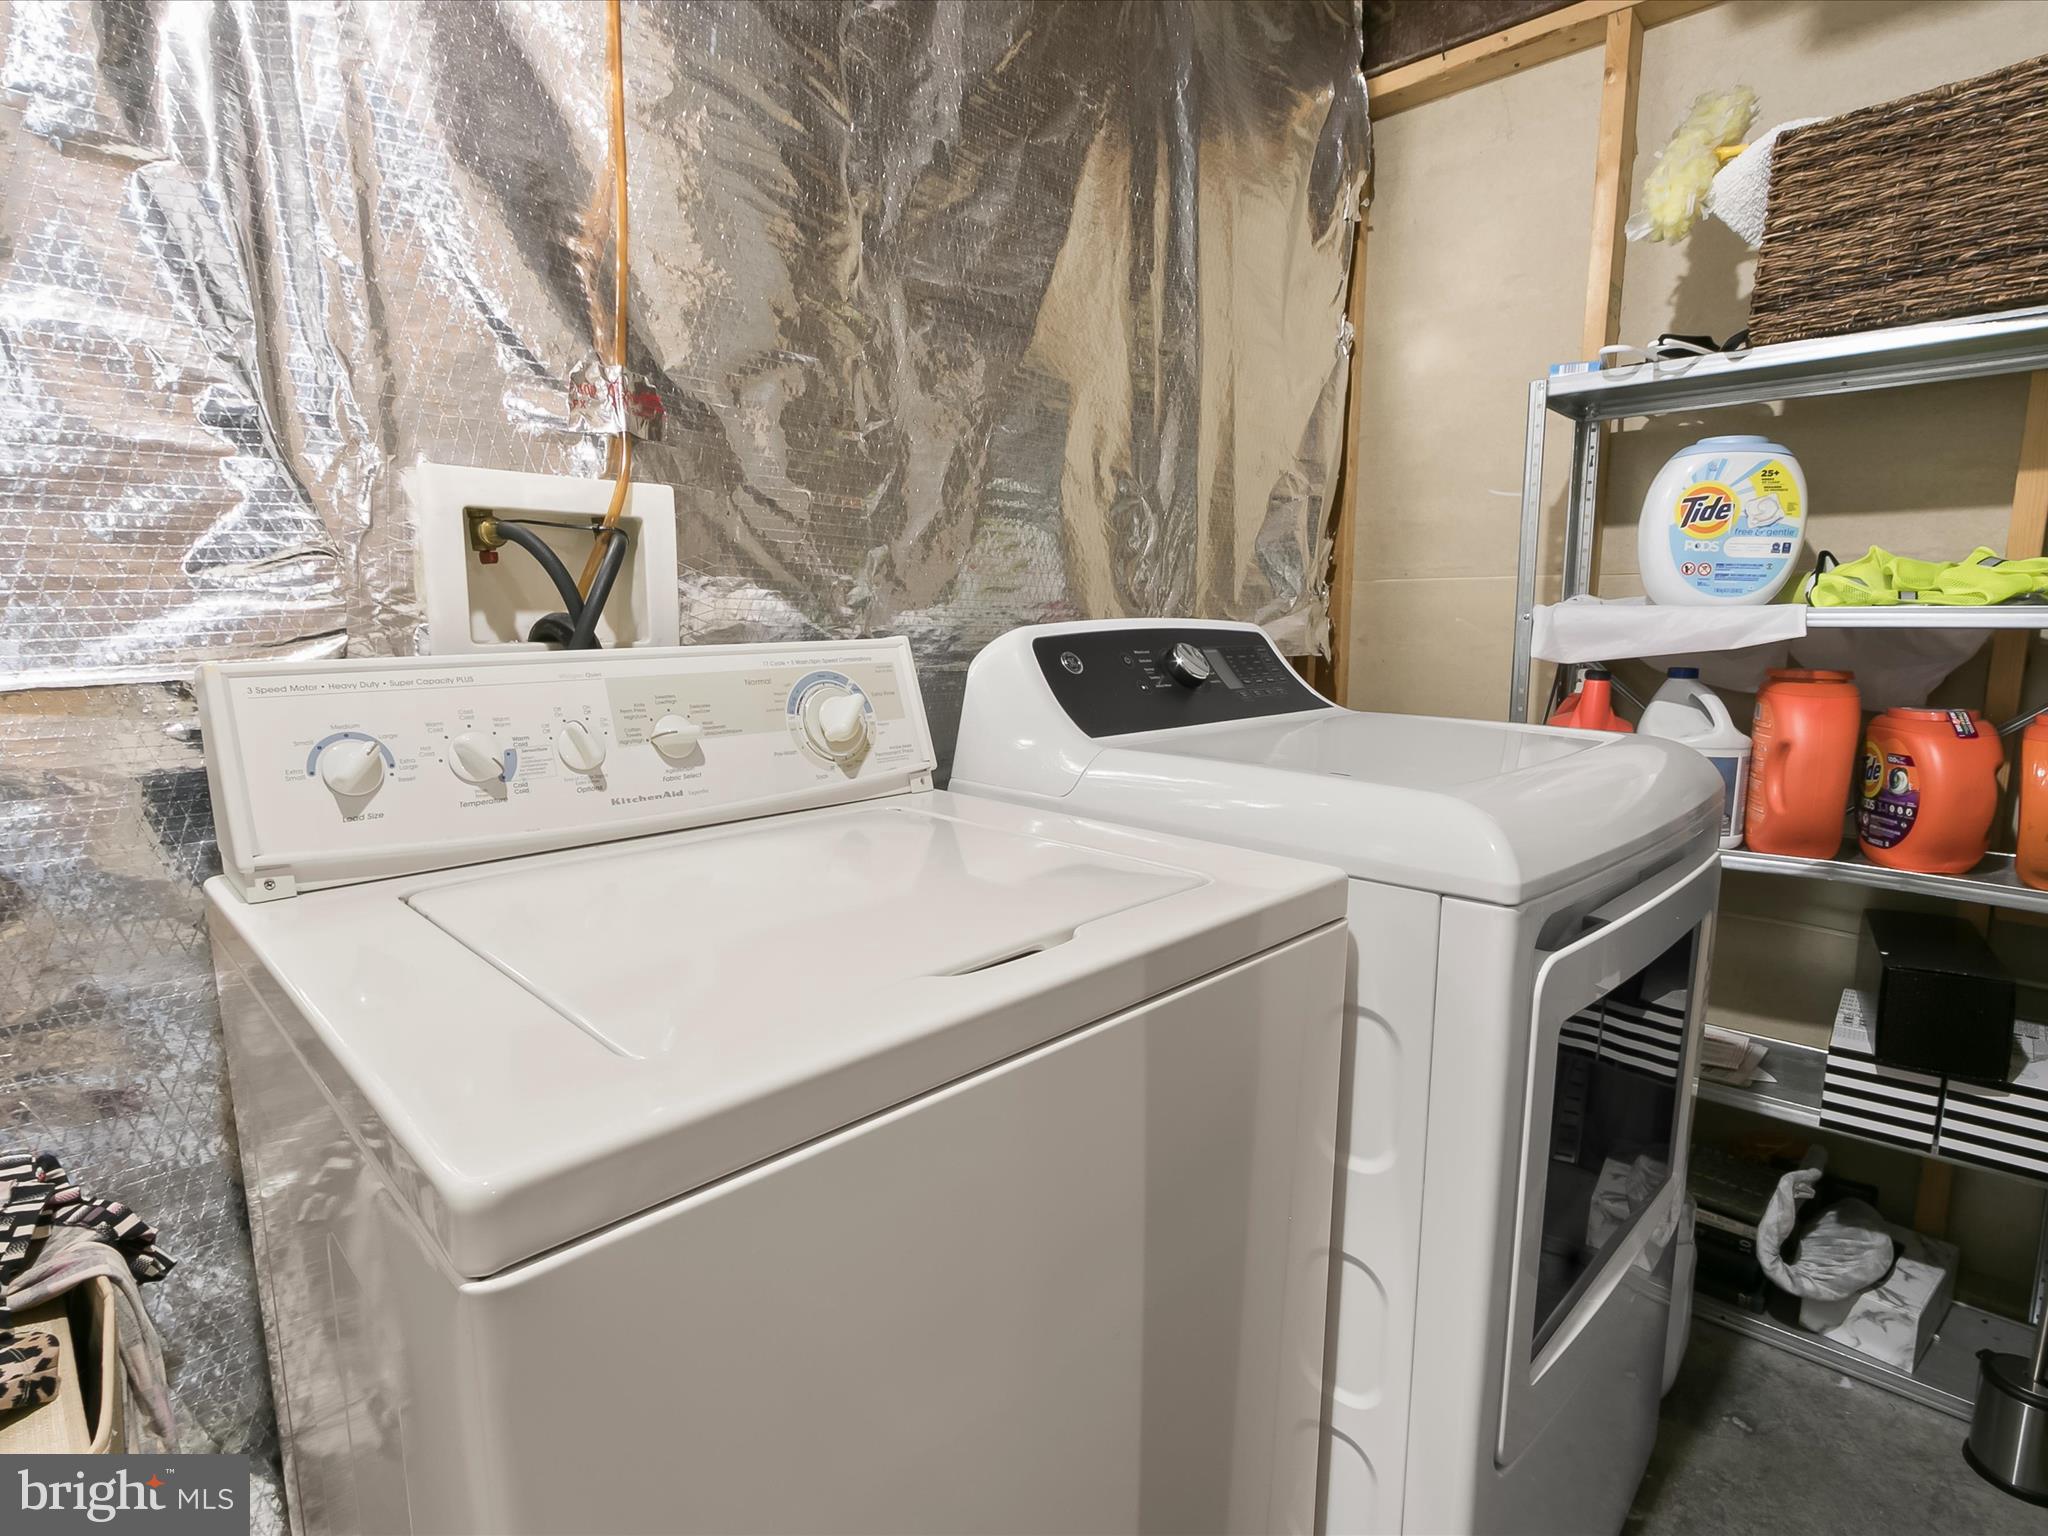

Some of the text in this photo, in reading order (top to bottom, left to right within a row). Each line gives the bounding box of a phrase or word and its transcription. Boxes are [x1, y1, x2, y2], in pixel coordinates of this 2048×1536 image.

[1761, 469, 1780, 477] 25+
[1680, 495, 1732, 529] Tide
[1734, 528, 1753, 537] free
[1767, 528, 1796, 537] gentle
[247, 675, 474, 695] 3 Speed Motor Heavy Duty Super Capacity PLUS
[744, 678, 772, 686] Normal
[662, 772, 702, 783] Fabric Select
[576, 784, 604, 795] Options
[459, 796, 508, 809] Temperature
[610, 789, 684, 806] KitchenAid
[342, 811, 385, 823] Load Size
